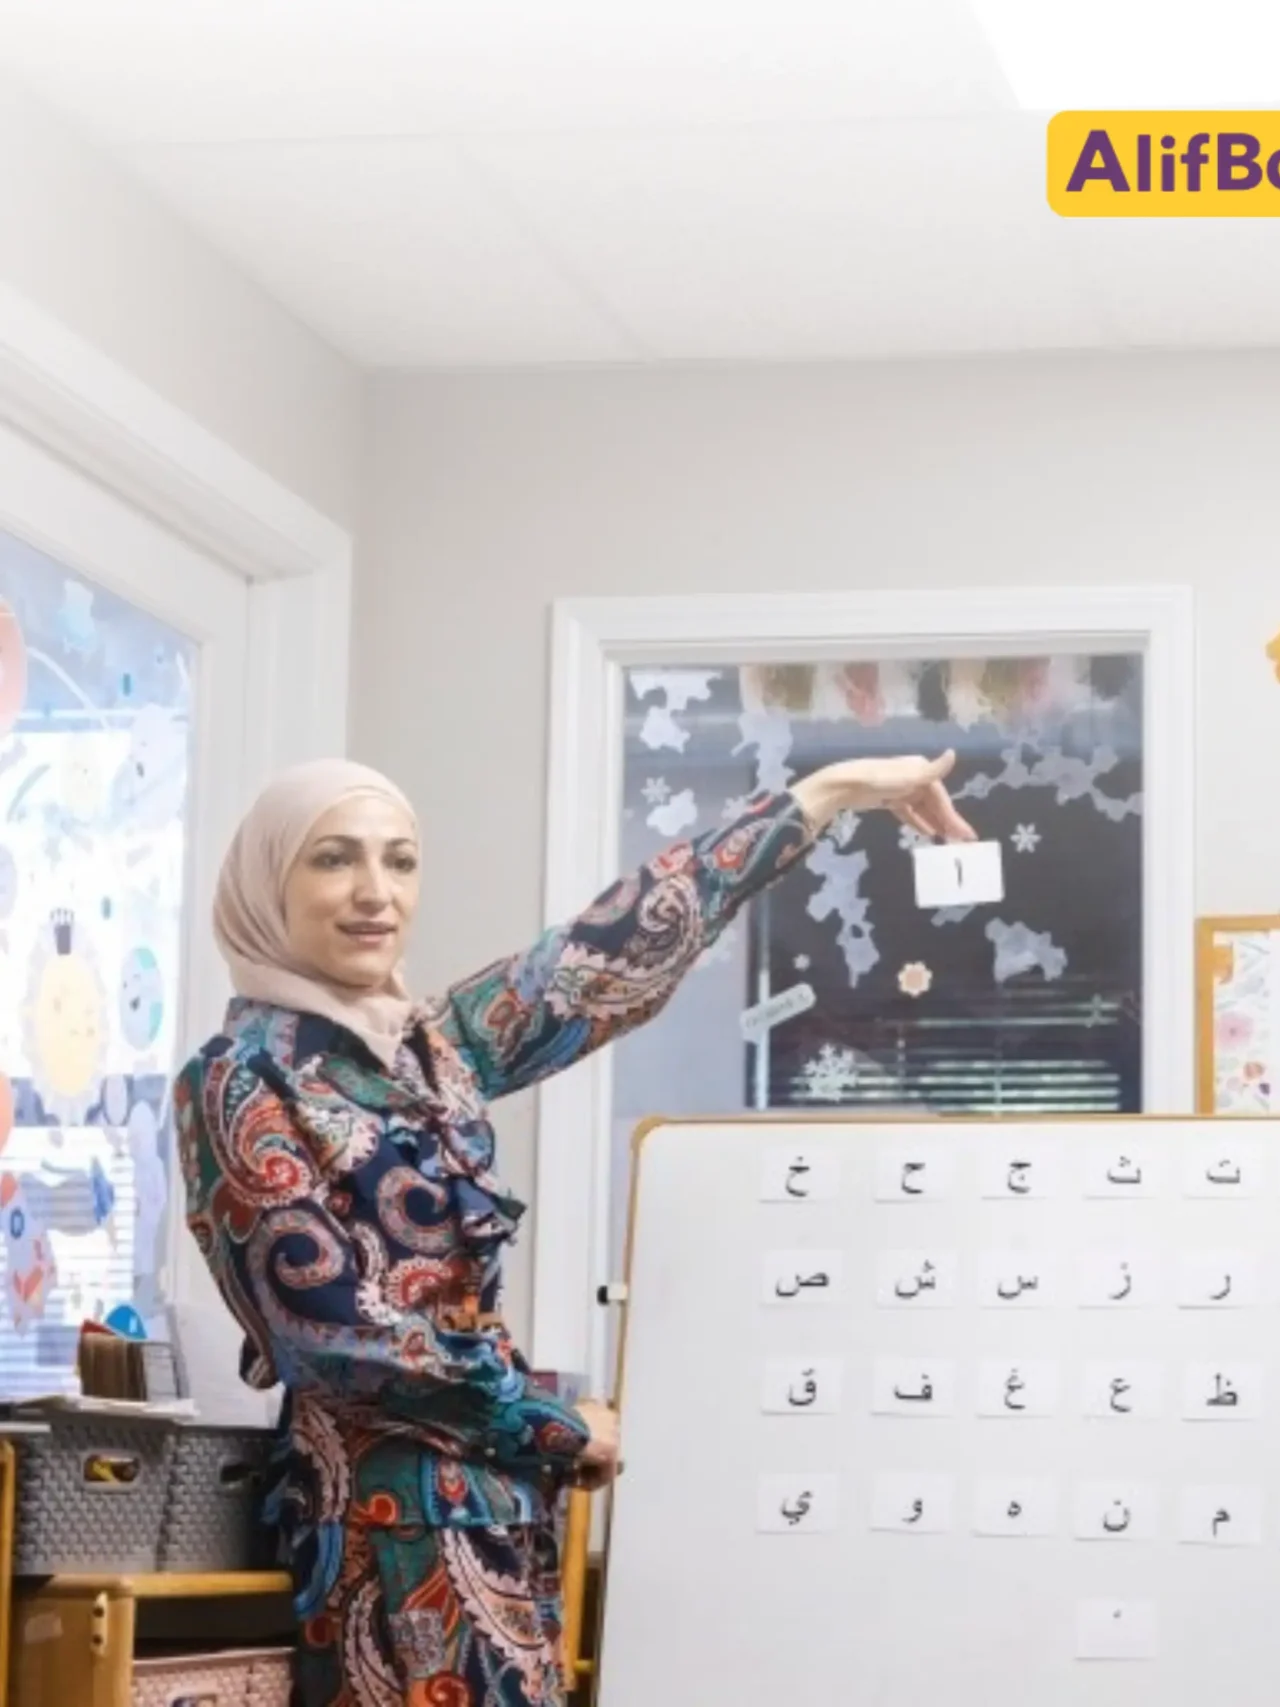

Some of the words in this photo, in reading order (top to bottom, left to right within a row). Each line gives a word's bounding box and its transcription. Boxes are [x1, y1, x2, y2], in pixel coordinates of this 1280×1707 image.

[784, 1156, 811, 1198] خ
[900, 1162, 926, 1196] ح
[1006, 1161, 1032, 1195] ج
[1106, 1155, 1142, 1185] ث
[1205, 1159, 1241, 1185] ت
[774, 1271, 830, 1299] ص
[894, 1259, 937, 1301] ش
[996, 1275, 1038, 1301] س
[1109, 1262, 1132, 1301] ز
[1209, 1274, 1232, 1301] ر
[787, 1368, 818, 1408] ق
[893, 1373, 934, 1403] ف
[1109, 1377, 1132, 1414] ع
[1205, 1372, 1239, 1407] ظ
[902, 1498, 924, 1525] و
[1102, 1499, 1131, 1533] ن
[1211, 1508, 1231, 1537] م
